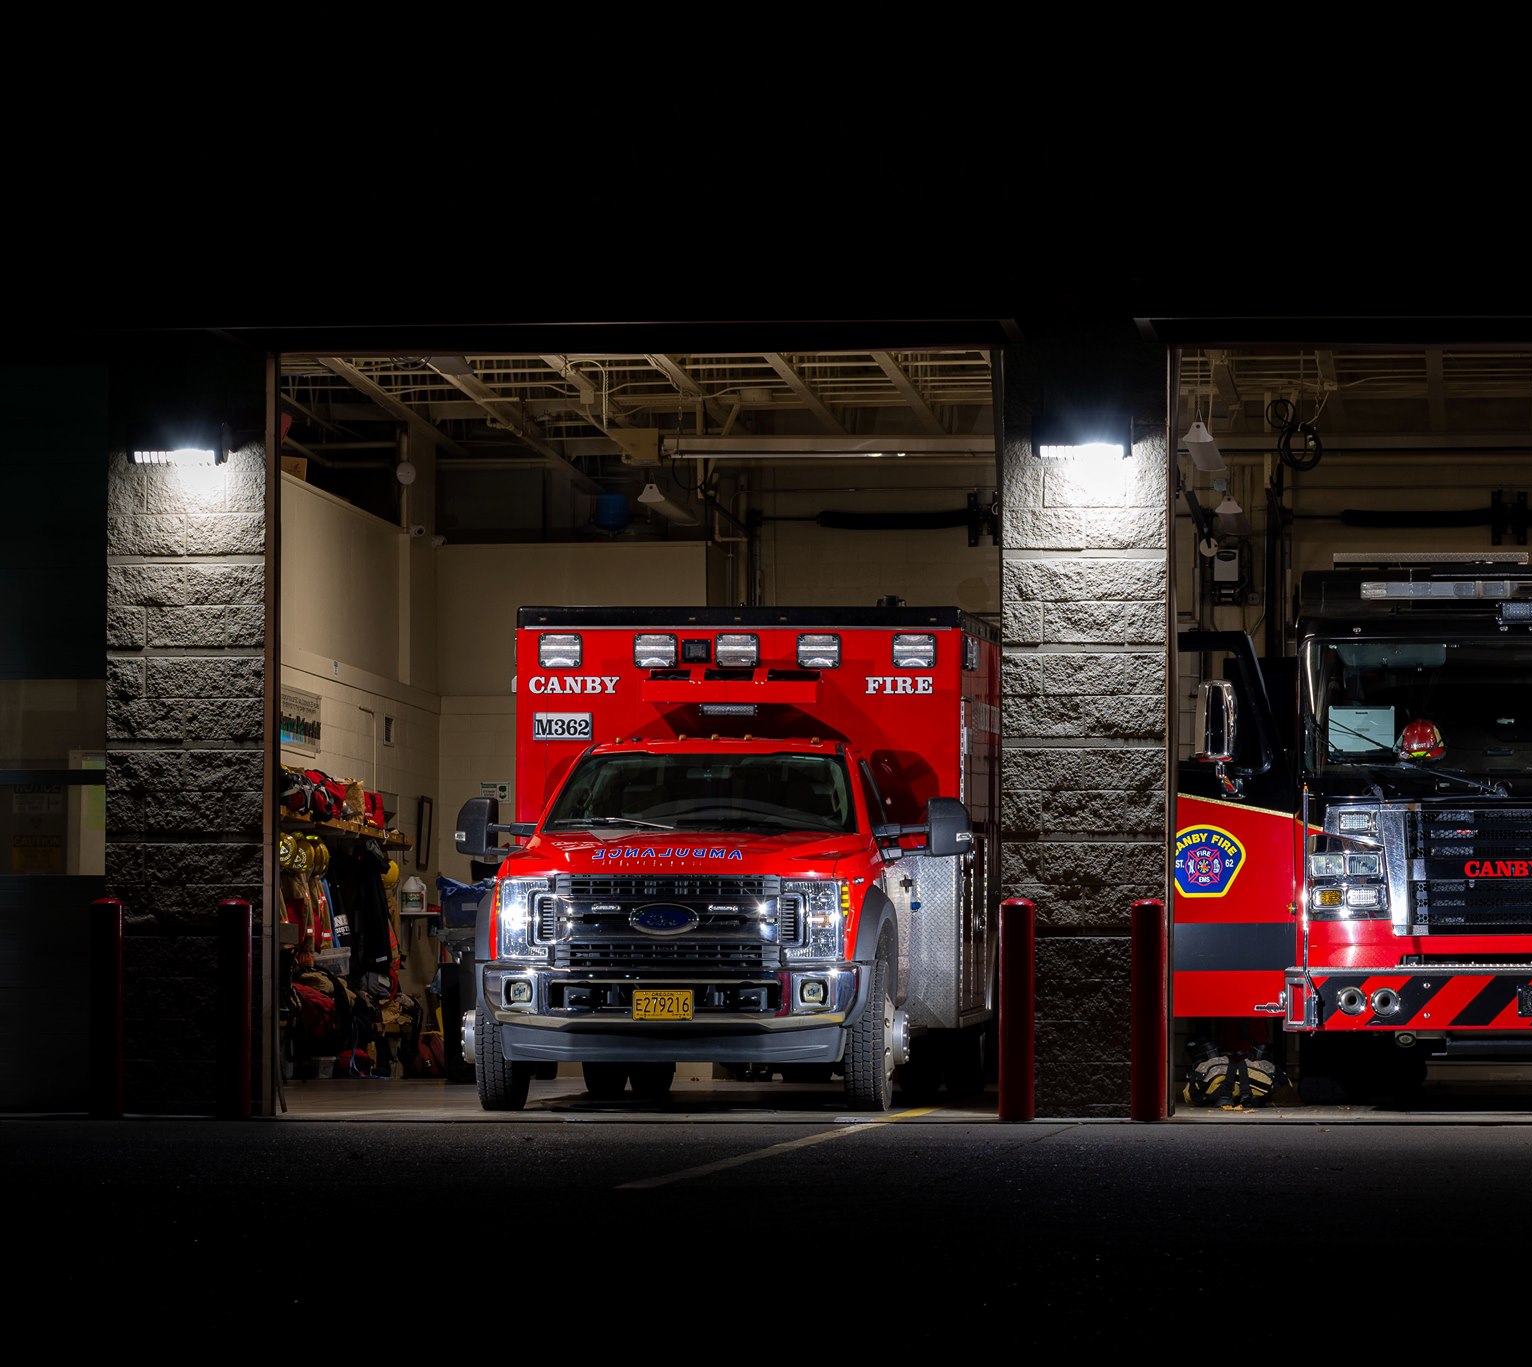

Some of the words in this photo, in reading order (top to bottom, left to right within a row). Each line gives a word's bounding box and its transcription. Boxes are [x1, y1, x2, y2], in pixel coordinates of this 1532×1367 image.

[528, 675, 620, 694] CANBY
[865, 676, 933, 695] FIRE
[535, 718, 590, 736] M362
[1211, 834, 1238, 856] FIRE
[1175, 859, 1185, 868] ST.
[1225, 859, 1234, 868] 62
[636, 997, 690, 1013] E279216
